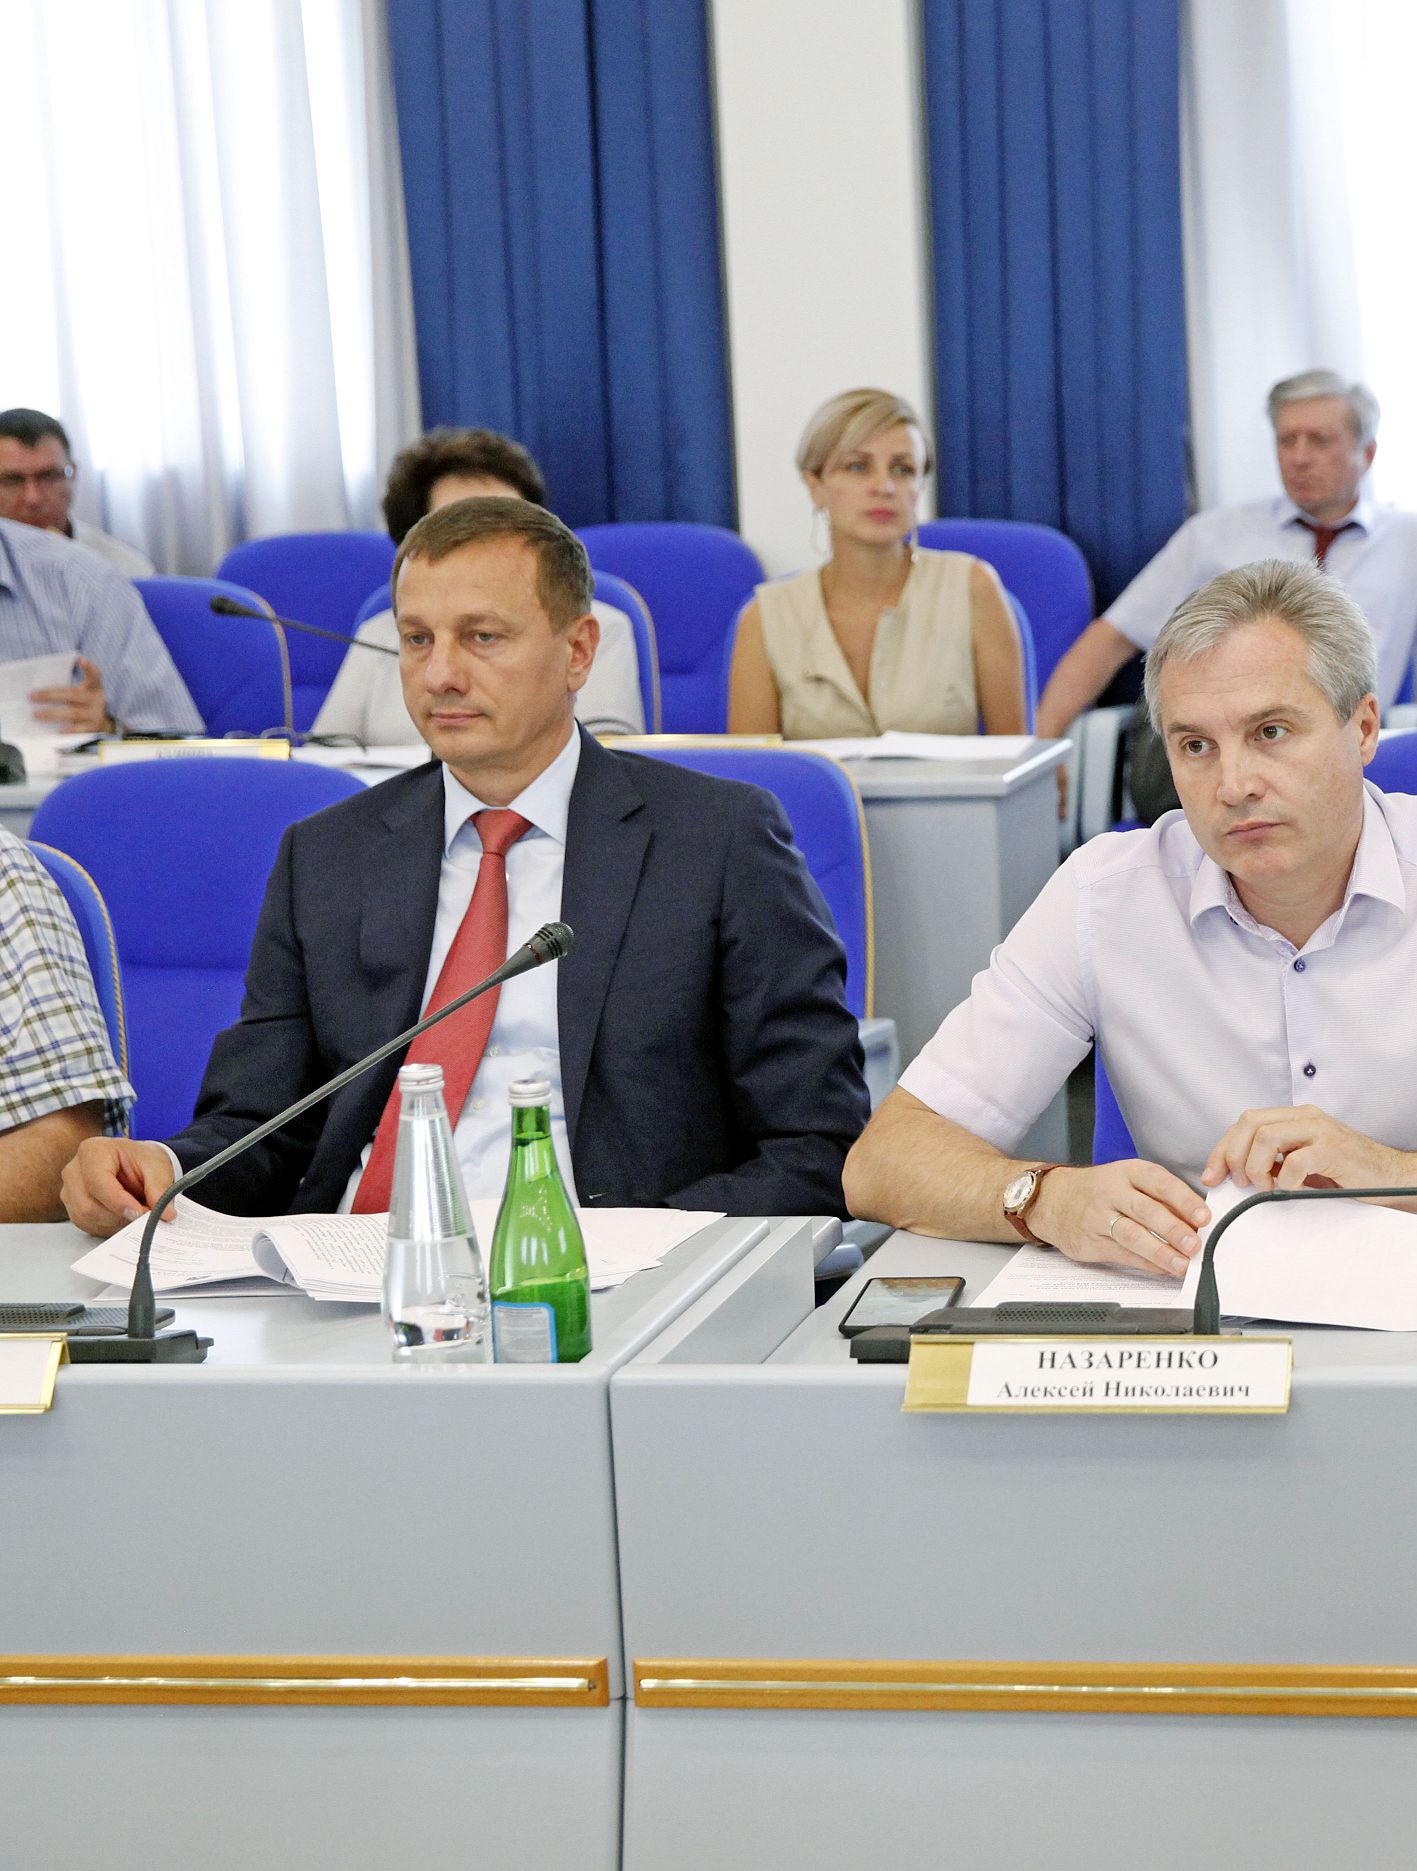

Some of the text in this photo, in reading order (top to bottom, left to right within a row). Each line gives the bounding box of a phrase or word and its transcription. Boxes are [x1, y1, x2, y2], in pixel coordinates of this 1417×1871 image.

[1037, 1349, 1219, 1370] НАЗАРЕНКО
[997, 1380, 1250, 1398] Алексей Николаевич
